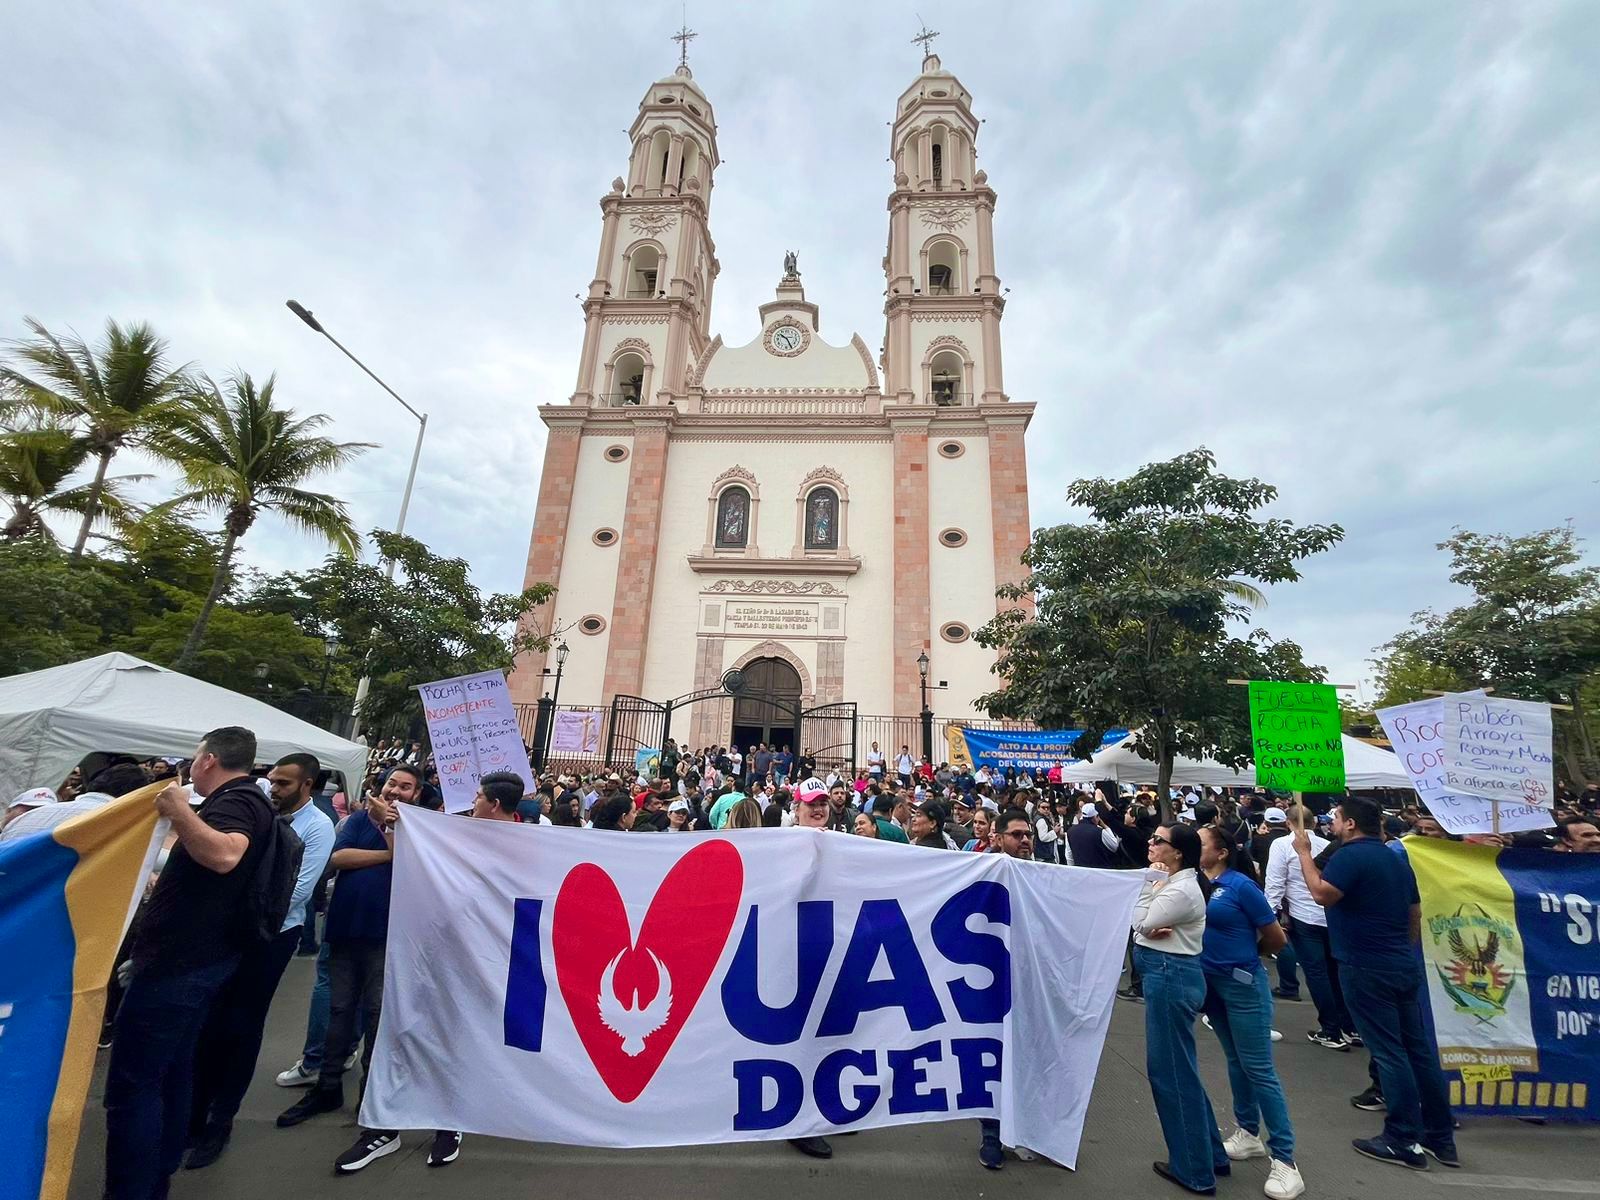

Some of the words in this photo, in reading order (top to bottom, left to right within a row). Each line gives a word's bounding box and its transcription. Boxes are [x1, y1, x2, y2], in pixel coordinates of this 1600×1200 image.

[423, 684, 463, 701] ROCHA
[467, 682, 483, 691] ES
[482, 680, 503, 691] TAN
[1253, 690, 1324, 709] FUERA
[1458, 702, 1523, 726] Rubén
[1257, 713, 1325, 733] ROCHA
[431, 727, 454, 738] QUE
[448, 736, 469, 748] UAS
[998, 742, 1020, 750] ALTO
[1022, 743, 1029, 751] A
[1255, 738, 1323, 753] PERSONA
[1325, 739, 1343, 752] NO
[979, 750, 1038, 759] ACOSADORES
[998, 760, 1016, 768] DEL
[1261, 755, 1306, 769] GRATA
[807, 781, 825, 791] UAS
[1259, 772, 1287, 786] UAS
[504, 898, 547, 1052] I
[721, 880, 1012, 1045] UAS
[1546, 975, 1572, 998] en
[1556, 1011, 1594, 1040] por
[1442, 1053, 1478, 1064] SOMOS
[1480, 1054, 1532, 1066] GRANDES
[733, 1037, 1003, 1131] DGEP
